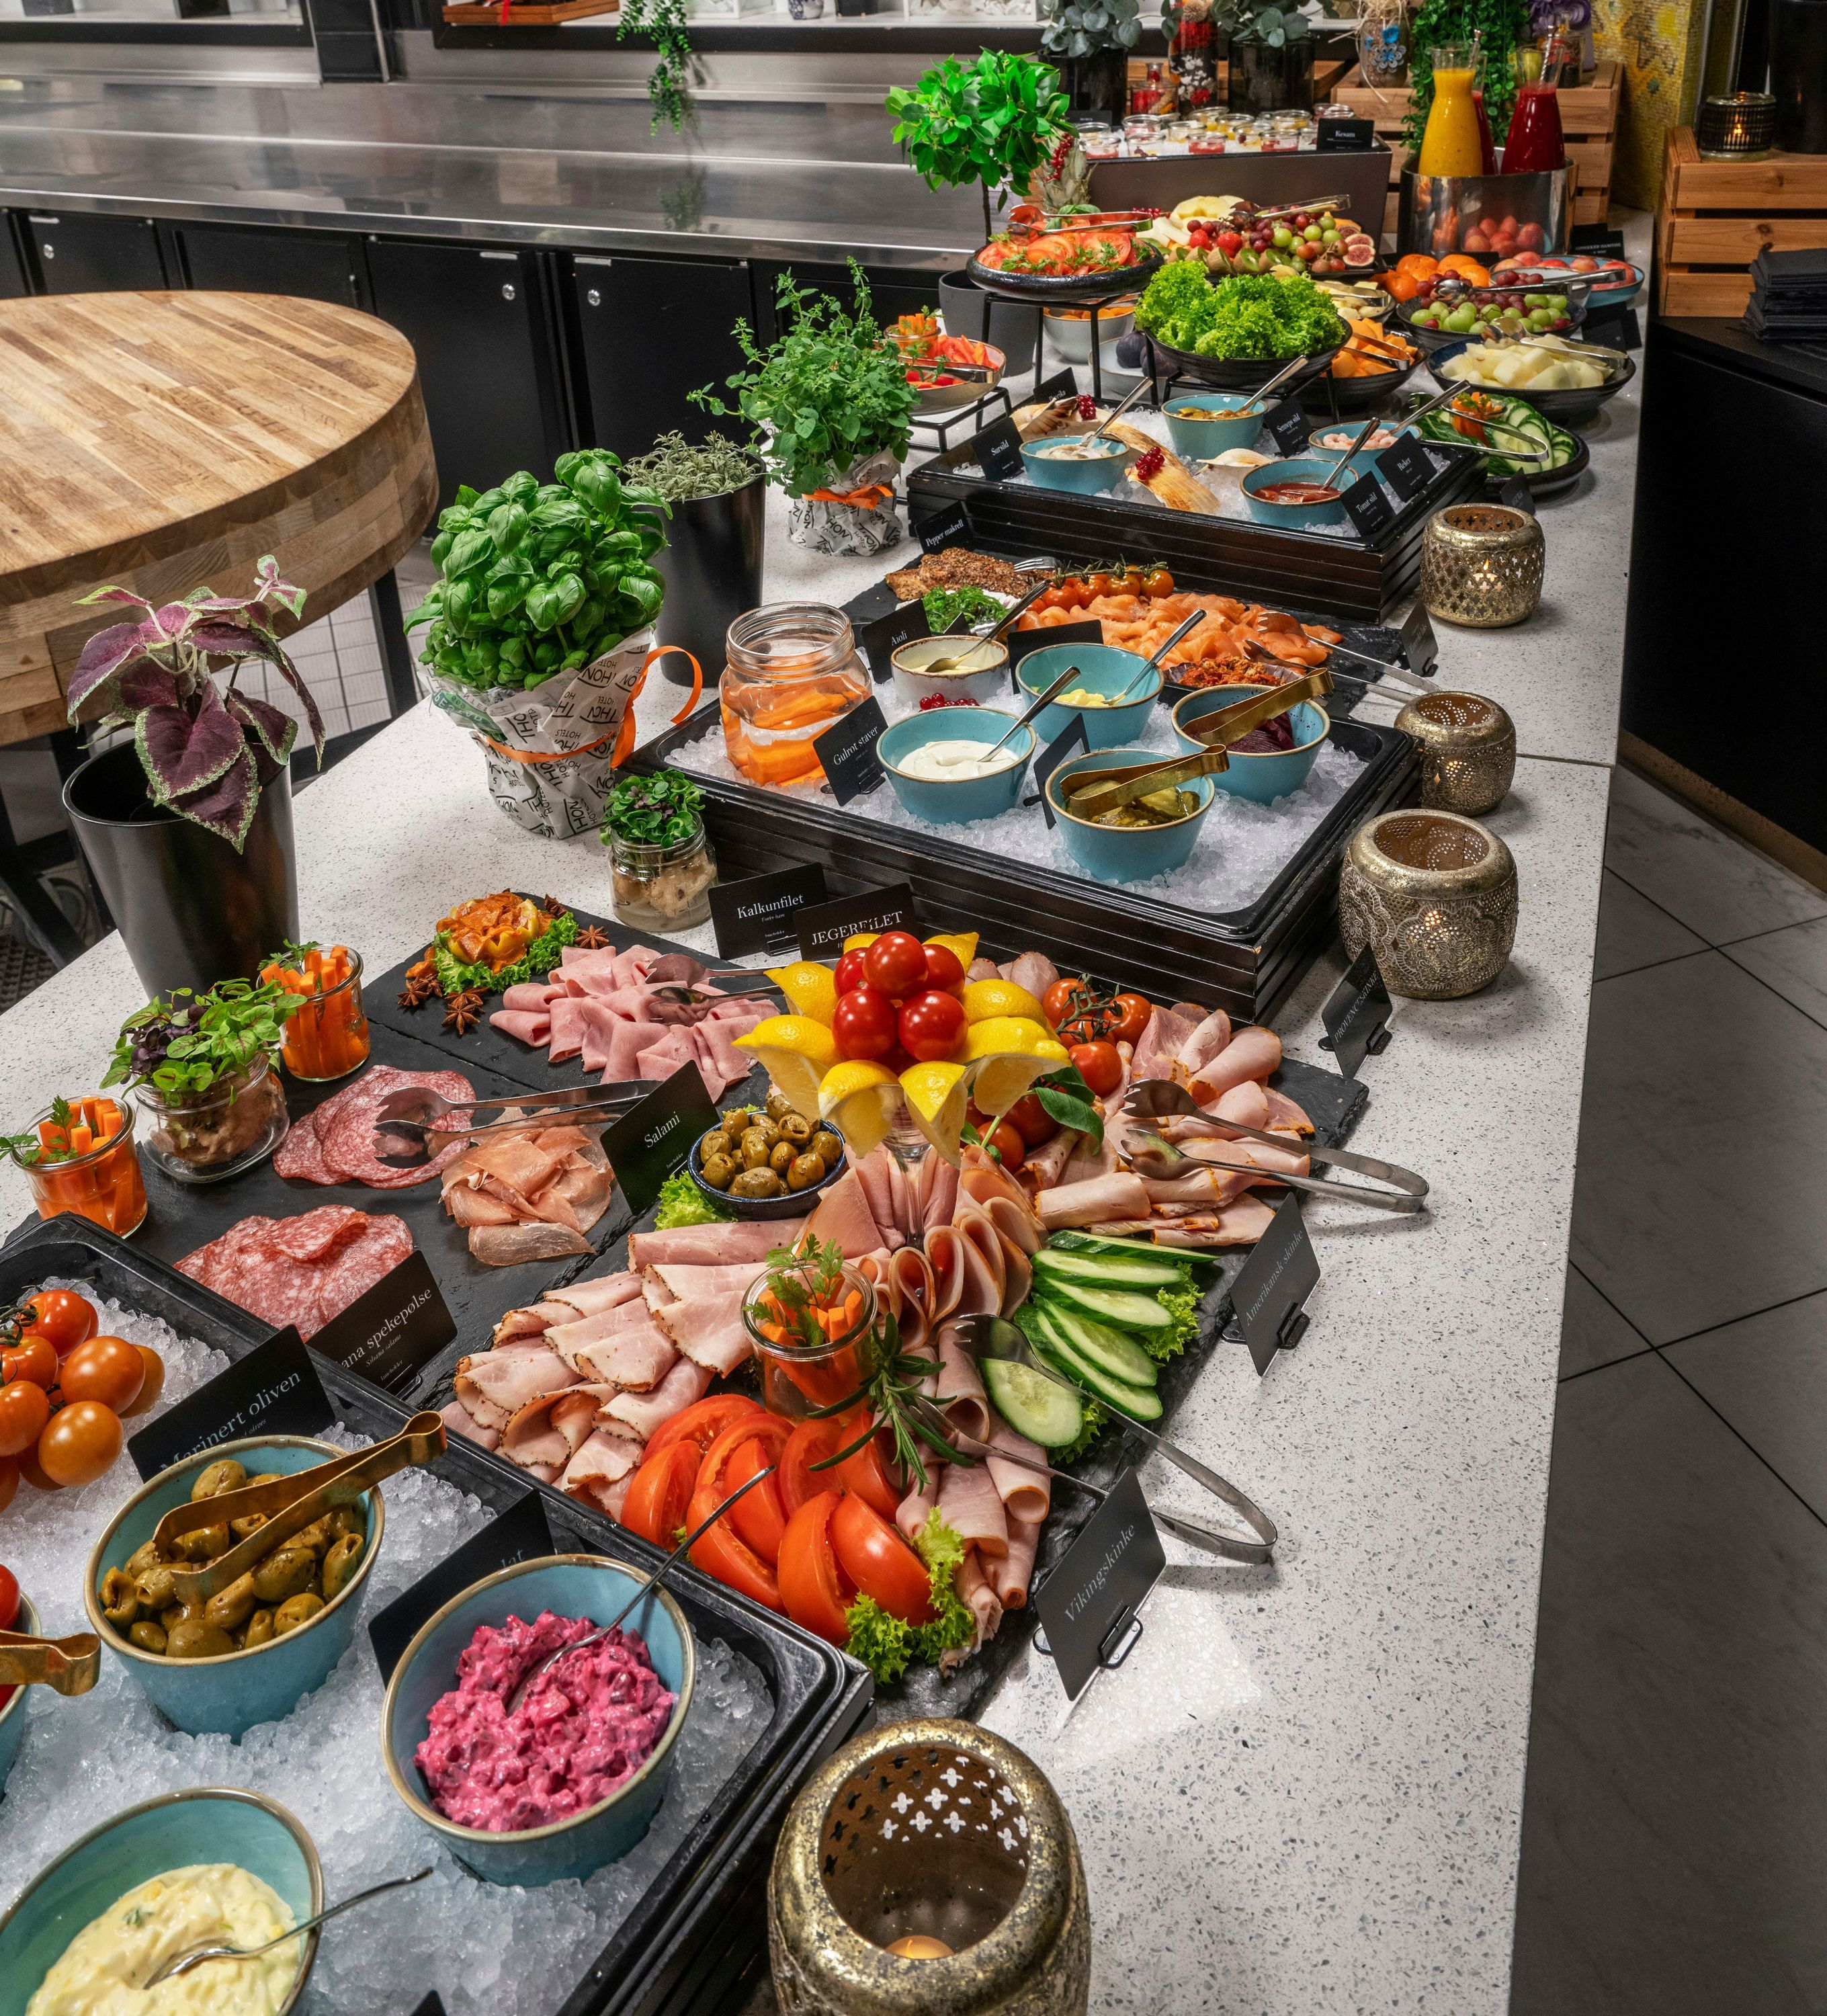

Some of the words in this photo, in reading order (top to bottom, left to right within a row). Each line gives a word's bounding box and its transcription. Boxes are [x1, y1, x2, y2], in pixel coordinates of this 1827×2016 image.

[1334, 130, 1355, 138] Kesam
[1049, 390, 1066, 401] Prika
[1293, 413, 1301, 423] sild
[990, 439, 1009, 456] Sursild
[1397, 457, 1412, 470] Reker
[1355, 499, 1371, 513] Tomat
[1369, 492, 1377, 503] sild
[925, 532, 944, 546] Pepper
[944, 519, 964, 536] makrell
[892, 630, 908, 646] Aioli
[556, 729, 581, 739] HOTELS
[833, 742, 859, 765] Gulrot
[858, 726, 878, 747] staver
[737, 894, 804, 919] Kalkunfilet
[644, 1111, 681, 1148] Salami
[1245, 1261, 1284, 1326] Amerikansk
[1283, 1230, 1303, 1264] skinke
[341, 1347, 366, 1368] ana
[367, 1289, 432, 1349] spekepølse
[249, 1372, 301, 1415] oliven
[1064, 1524, 1136, 1622] Vikingskinke
